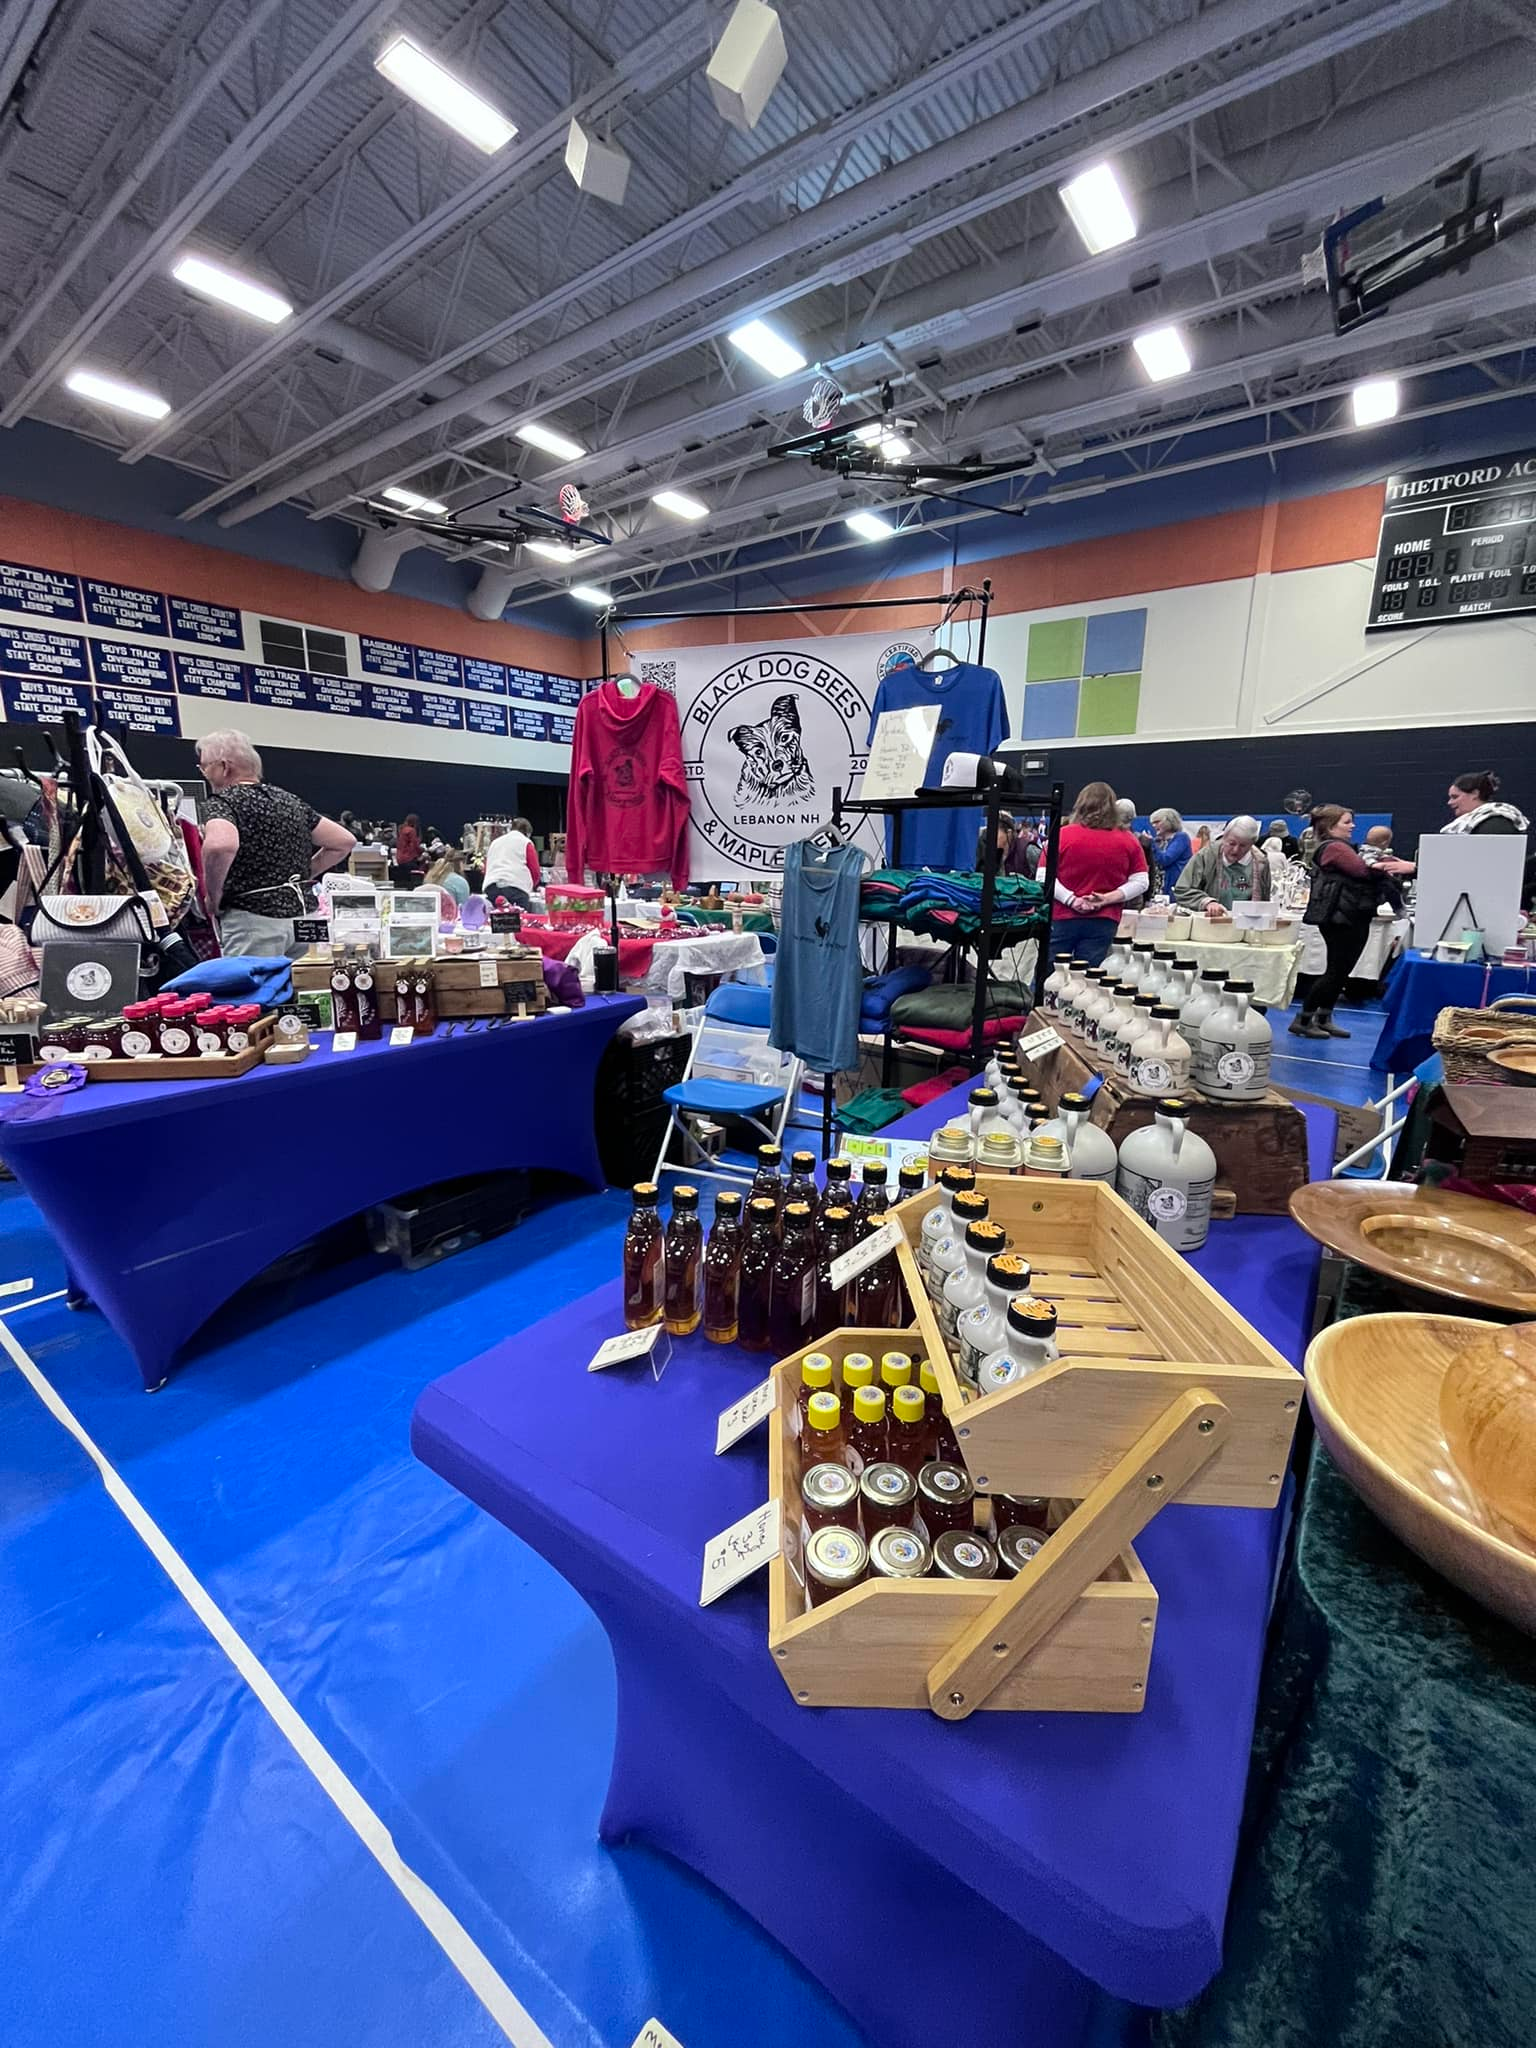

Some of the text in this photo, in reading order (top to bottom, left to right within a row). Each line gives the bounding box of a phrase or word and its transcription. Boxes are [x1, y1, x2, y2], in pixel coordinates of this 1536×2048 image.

[1390, 459, 1536, 499] THETFORD AC
[1394, 539, 1431, 556] HOME
[1471, 534, 1504, 547] PERIOD
[3, 576, 48, 592] DIVISION
[1450, 568, 1512, 585] PLAYER FOUL
[88, 583, 159, 605] FIELD HOCKEY
[1382, 581, 1409, 593] FOULS
[27, 590, 75, 608] CHAMPIONS
[98, 595, 139, 610] DIVISION
[1459, 601, 1491, 613] MATCH
[92, 602, 161, 624] STATE CHAMPIONS
[1377, 612, 1404, 623] SCORE
[12, 640, 56, 654] DIVISION
[22, 631, 47, 643] CROSS
[48, 635, 80, 649] COUNTRY
[6, 648, 82, 668] STATE CHAMPIONS
[101, 643, 162, 661] BOYS TRACK
[106, 654, 145, 667] DIVISION
[101, 662, 168, 680] STATE CHAMPIONS
[254, 667, 301, 683] BOYS TRACK
[183, 674, 205, 685] STATE
[20, 681, 74, 697] BOYS TRACK
[693, 658, 862, 726] BLACK DOG BEES
[19, 691, 63, 705] DIVISION
[13, 700, 41, 713] STATE
[112, 701, 152, 714] DIVISION
[37, 713, 65, 724] 202
[107, 710, 174, 726] STATE CHAMPIONS
[128, 722, 157, 733] 2021
[851, 760, 868, 770] 20
[733, 813, 820, 825] LEBANON NH
[703, 818, 719, 835] &
[717, 832, 785, 867] MAPLE
